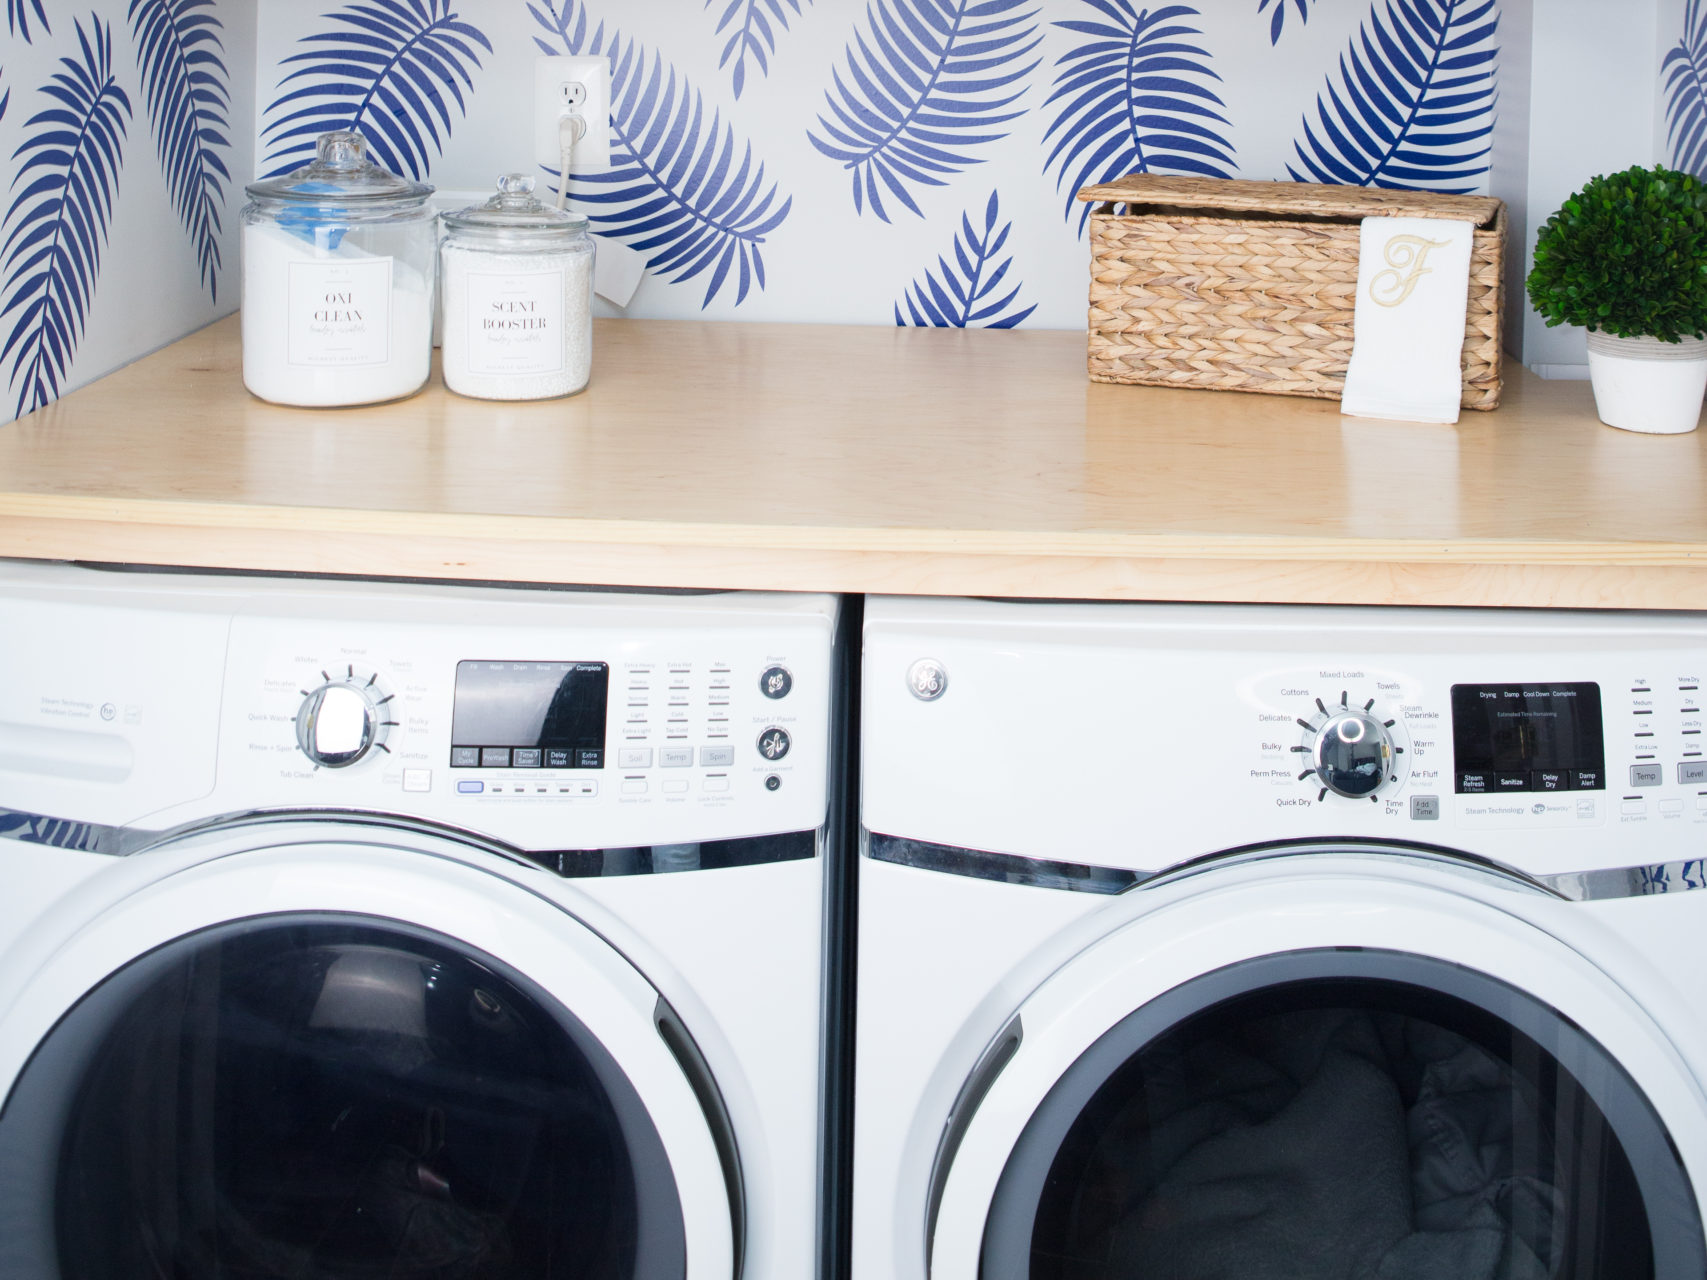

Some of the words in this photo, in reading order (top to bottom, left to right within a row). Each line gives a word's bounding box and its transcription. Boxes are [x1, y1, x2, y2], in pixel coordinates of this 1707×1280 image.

[1369, 233, 1454, 308] F
[325, 292, 352, 304] OXI
[492, 300, 537, 312] SCENT
[314, 310, 364, 322] CLEAN
[483, 318, 547, 330] BOOSTER
[1342, 671, 1365, 679] Loads
[1376, 682, 1401, 690] Towels
[1280, 688, 1309, 696] Cottons
[1399, 704, 1423, 712] Steam
[1259, 714, 1292, 722] Delicates
[1404, 711, 1439, 719] Dewrinkle
[1261, 743, 1282, 752] Bulky
[550, 751, 567, 759] Delay
[1414, 748, 1424, 756] Up
[666, 754, 686, 762] Temp
[709, 752, 726, 761] Spin
[1411, 770, 1422, 778] Air
[1422, 770, 1439, 778] Fluff
[1636, 772, 1656, 781] Temp
[1686, 770, 1704, 778] Level
[1276, 798, 1297, 807] Quick
[1298, 798, 1312, 808] Dry
[1386, 807, 1398, 816] Dry
[1465, 807, 1486, 815] Steam
[1488, 807, 1525, 816] Technology
